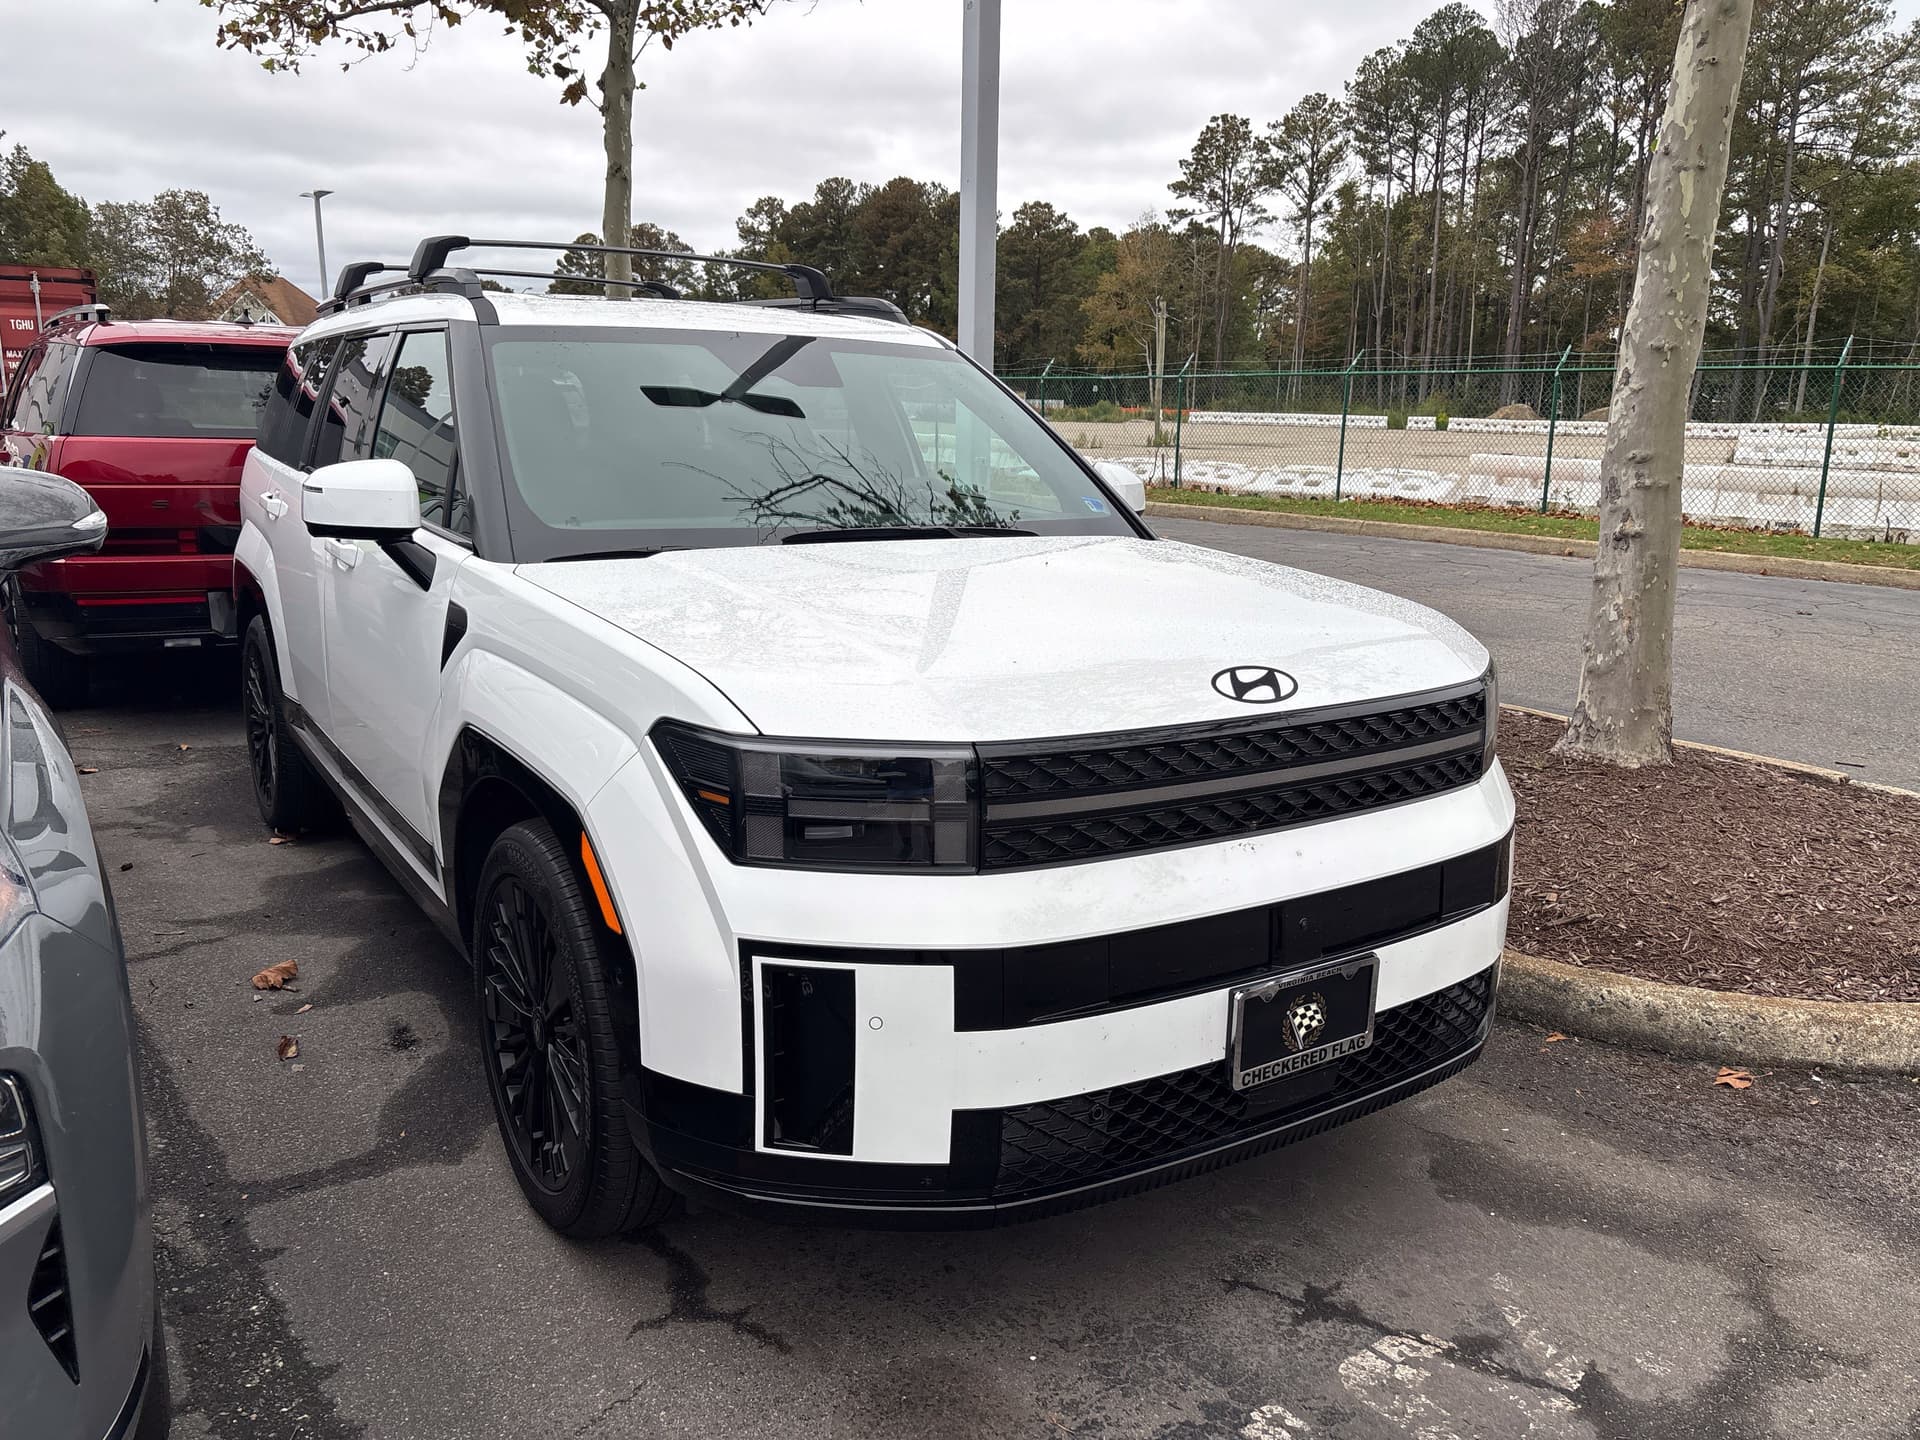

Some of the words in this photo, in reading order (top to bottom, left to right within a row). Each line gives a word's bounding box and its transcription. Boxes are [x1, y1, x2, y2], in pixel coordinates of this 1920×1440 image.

[9, 319, 34, 330] TGHU
[6, 350, 23, 358] MAX
[1278, 974, 1314, 989] VIRGINIA
[1316, 967, 1342, 979] BEACH
[1241, 1047, 1328, 1087] CHECKERED
[1331, 1036, 1366, 1058] FLAG
